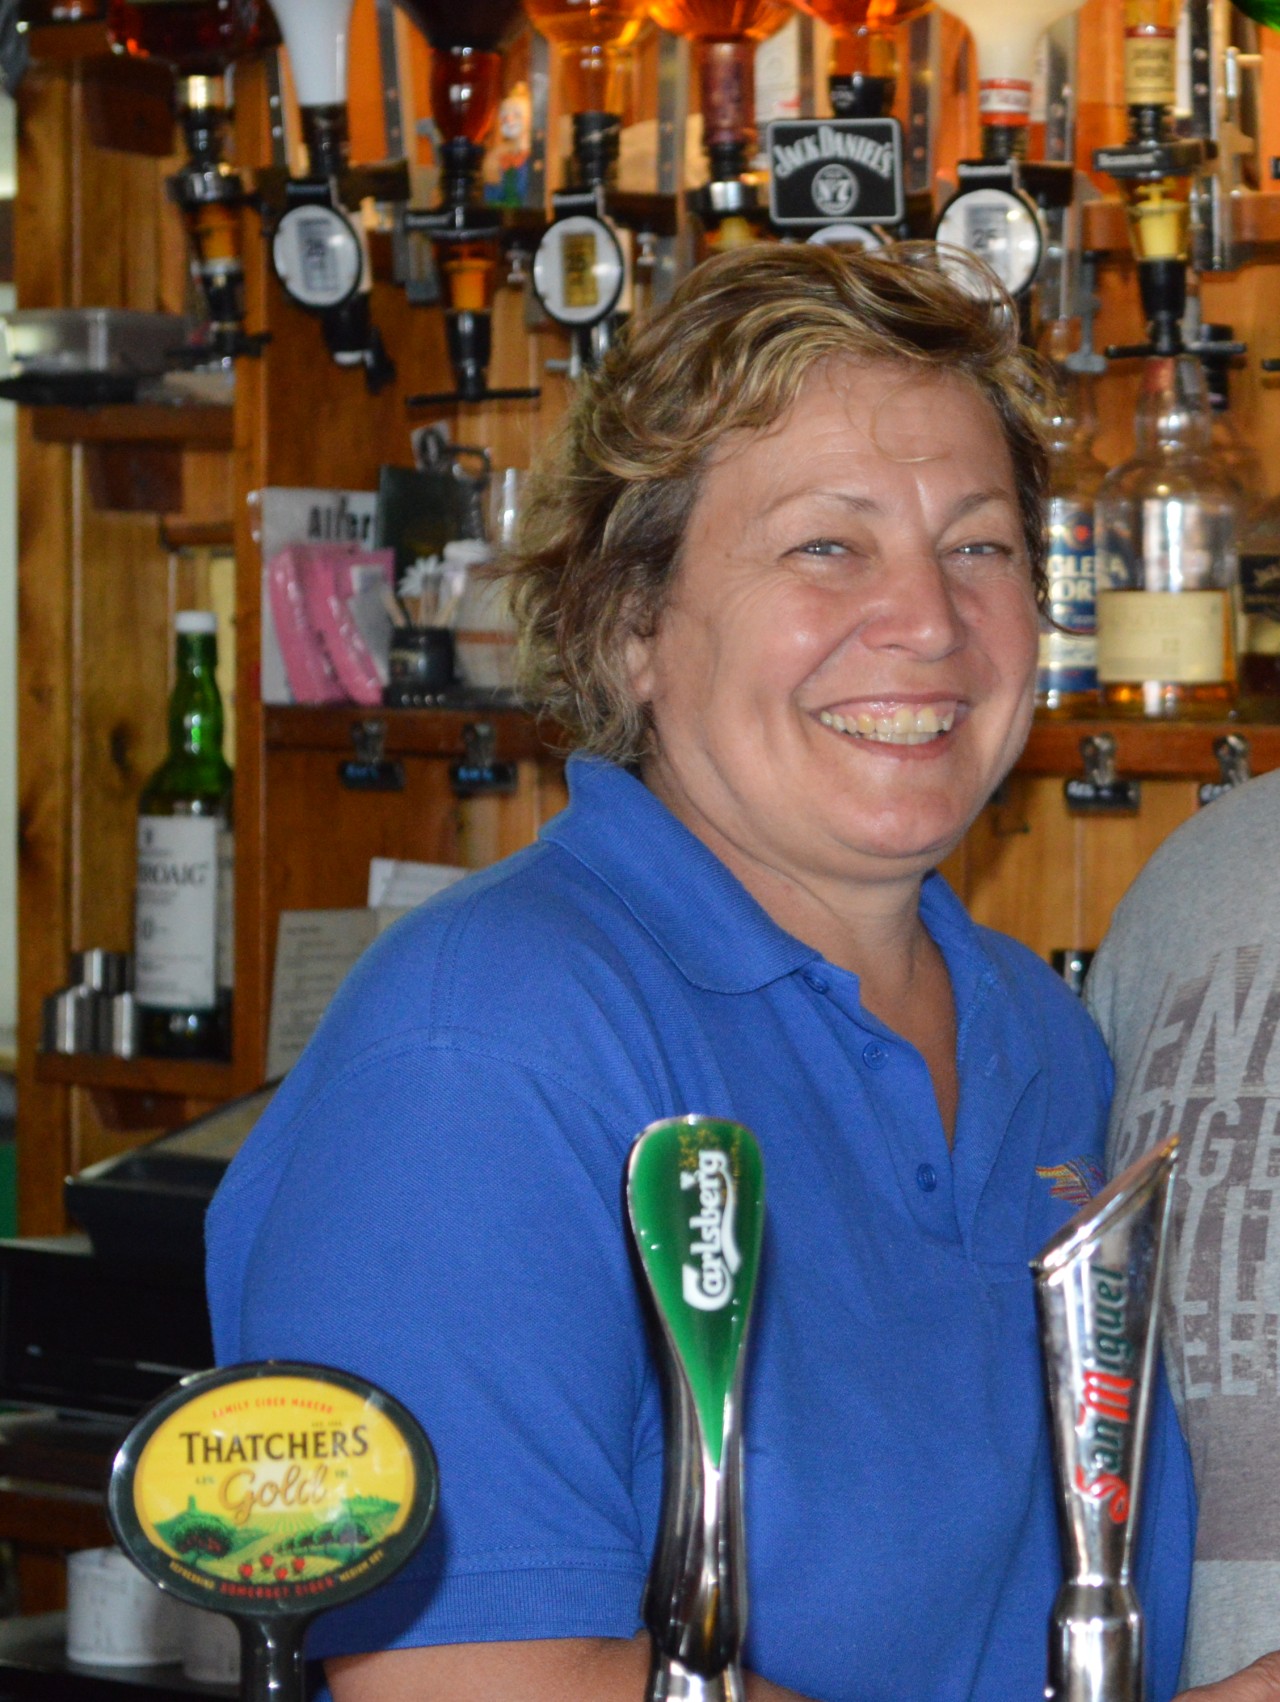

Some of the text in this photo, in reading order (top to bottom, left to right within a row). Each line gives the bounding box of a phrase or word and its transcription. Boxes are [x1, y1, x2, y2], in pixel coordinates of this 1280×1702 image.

[774, 134, 819, 179] JACK
[680, 1150, 740, 1312] Carlsberg
[1075, 1265, 1134, 1524] San Miguel
[178, 1424, 369, 1466] THATCHERS
[217, 1462, 329, 1527] Gold
